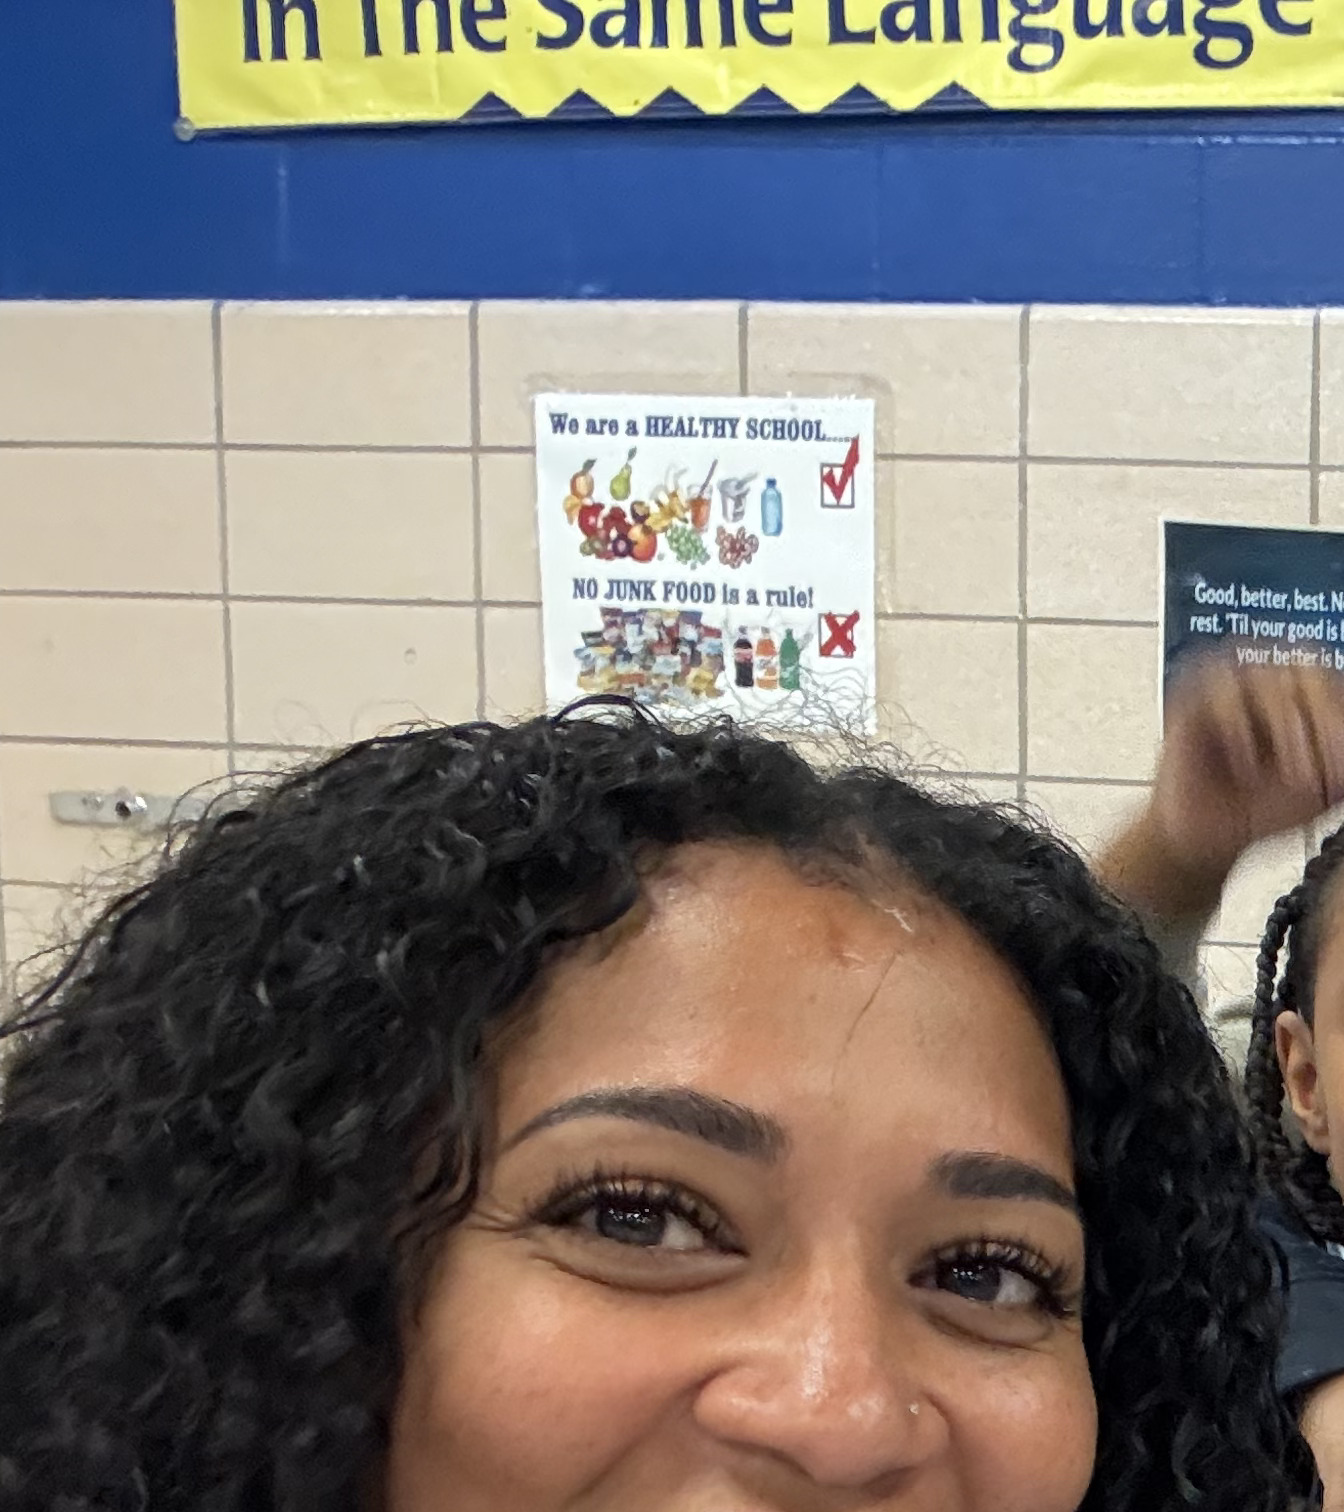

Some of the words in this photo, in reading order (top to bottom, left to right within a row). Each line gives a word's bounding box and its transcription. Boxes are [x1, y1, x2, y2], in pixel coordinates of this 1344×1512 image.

[535, 0, 794, 49] Same
[828, 0, 1312, 74] Language
[549, 412, 579, 435] We
[585, 418, 620, 436] are
[625, 419, 639, 437] a
[645, 415, 741, 439] HEALTHY
[573, 578, 599, 600] NO
[604, 579, 657, 602] JUNK
[662, 580, 717, 604] FOOD
[722, 582, 740, 605] is
[746, 587, 760, 606] a
[766, 585, 814, 609] rule!
[1194, 582, 1239, 609] Good,
[1241, 584, 1291, 612] better,
[1293, 587, 1329, 612] best.
[1190, 613, 1223, 634] rest.
[1251, 620, 1286, 641] your
[1287, 618, 1324, 643] good
[1326, 618, 1338, 642] is
[1236, 645, 1271, 668] your
[1272, 643, 1318, 667] better
[1321, 646, 1333, 669] is
